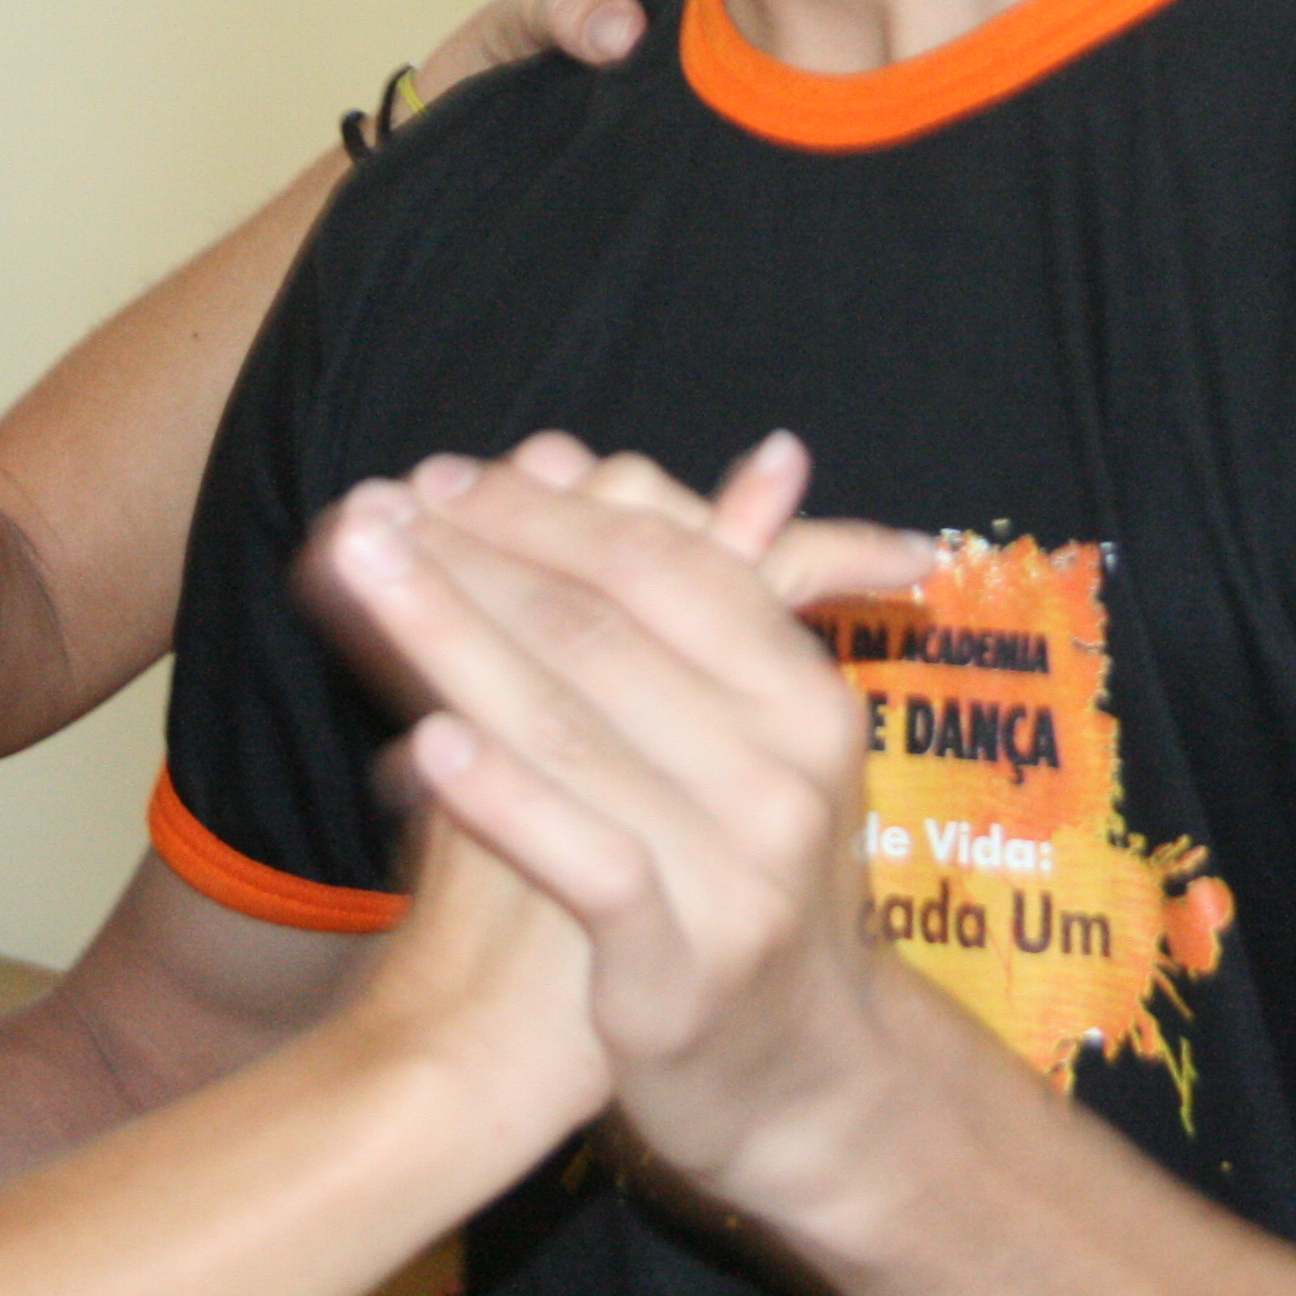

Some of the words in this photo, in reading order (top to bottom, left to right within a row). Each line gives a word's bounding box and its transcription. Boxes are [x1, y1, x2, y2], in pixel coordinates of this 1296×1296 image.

[906, 694, 1059, 785] DANÇA
[924, 818, 1053, 872] Vida:
[1012, 890, 1111, 957] Um
